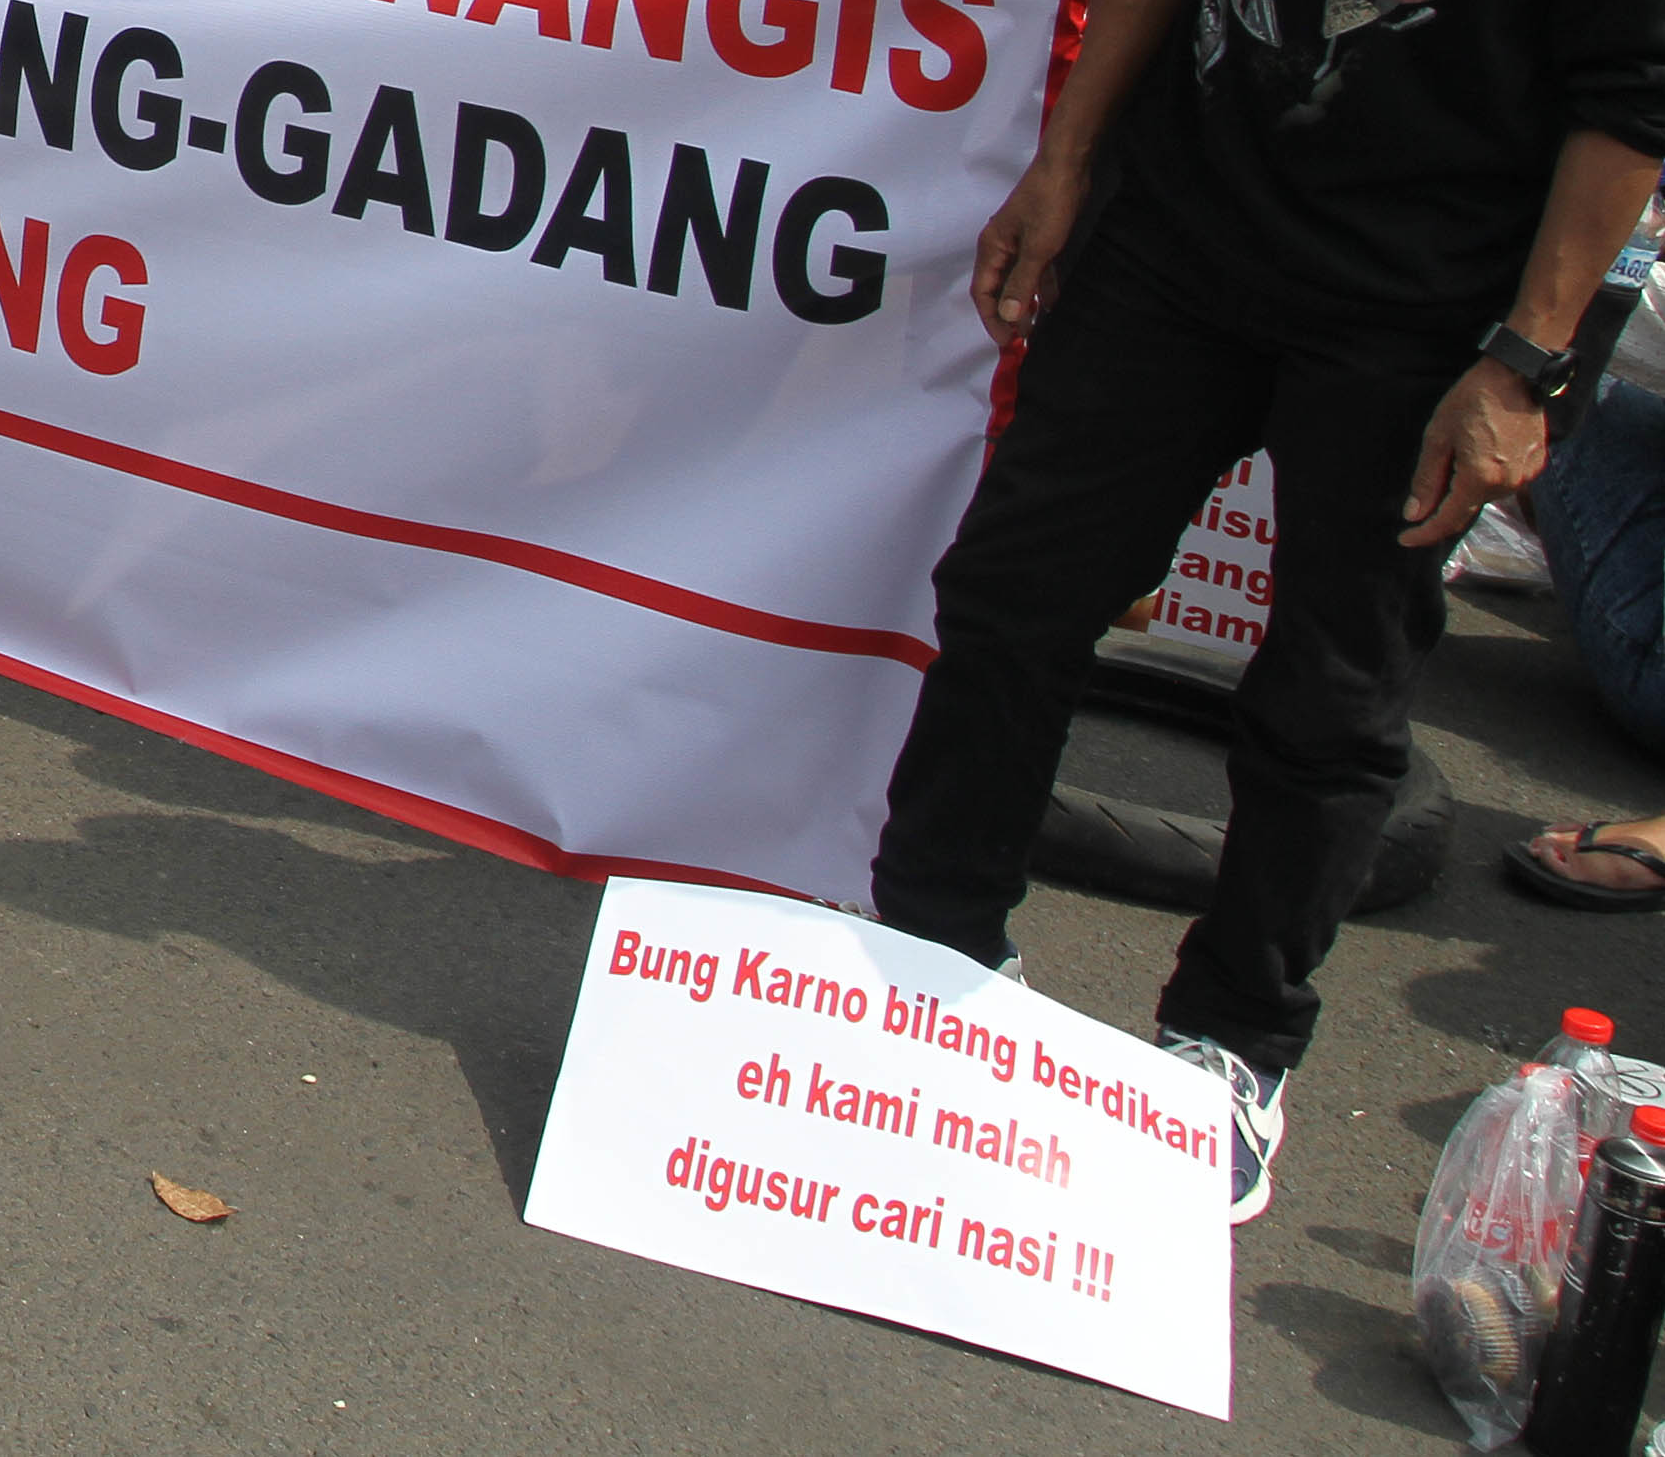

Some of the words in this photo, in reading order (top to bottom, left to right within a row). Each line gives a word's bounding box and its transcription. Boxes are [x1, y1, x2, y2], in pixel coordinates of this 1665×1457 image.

[1179, 551, 1273, 606] ang
[608, 928, 721, 1003] Bung
[731, 944, 869, 1025] Karno
[882, 984, 1019, 1084] bilang
[1031, 1039, 1219, 1168] berdikari
[735, 1052, 791, 1108] eh
[804, 1062, 922, 1139] kami
[932, 1107, 1073, 1191] malah
[665, 1135, 839, 1225] digusur
[851, 1192, 944, 1249] cari
[957, 1213, 1059, 1284] nasi
[1071, 1242, 1115, 1303] !!!
